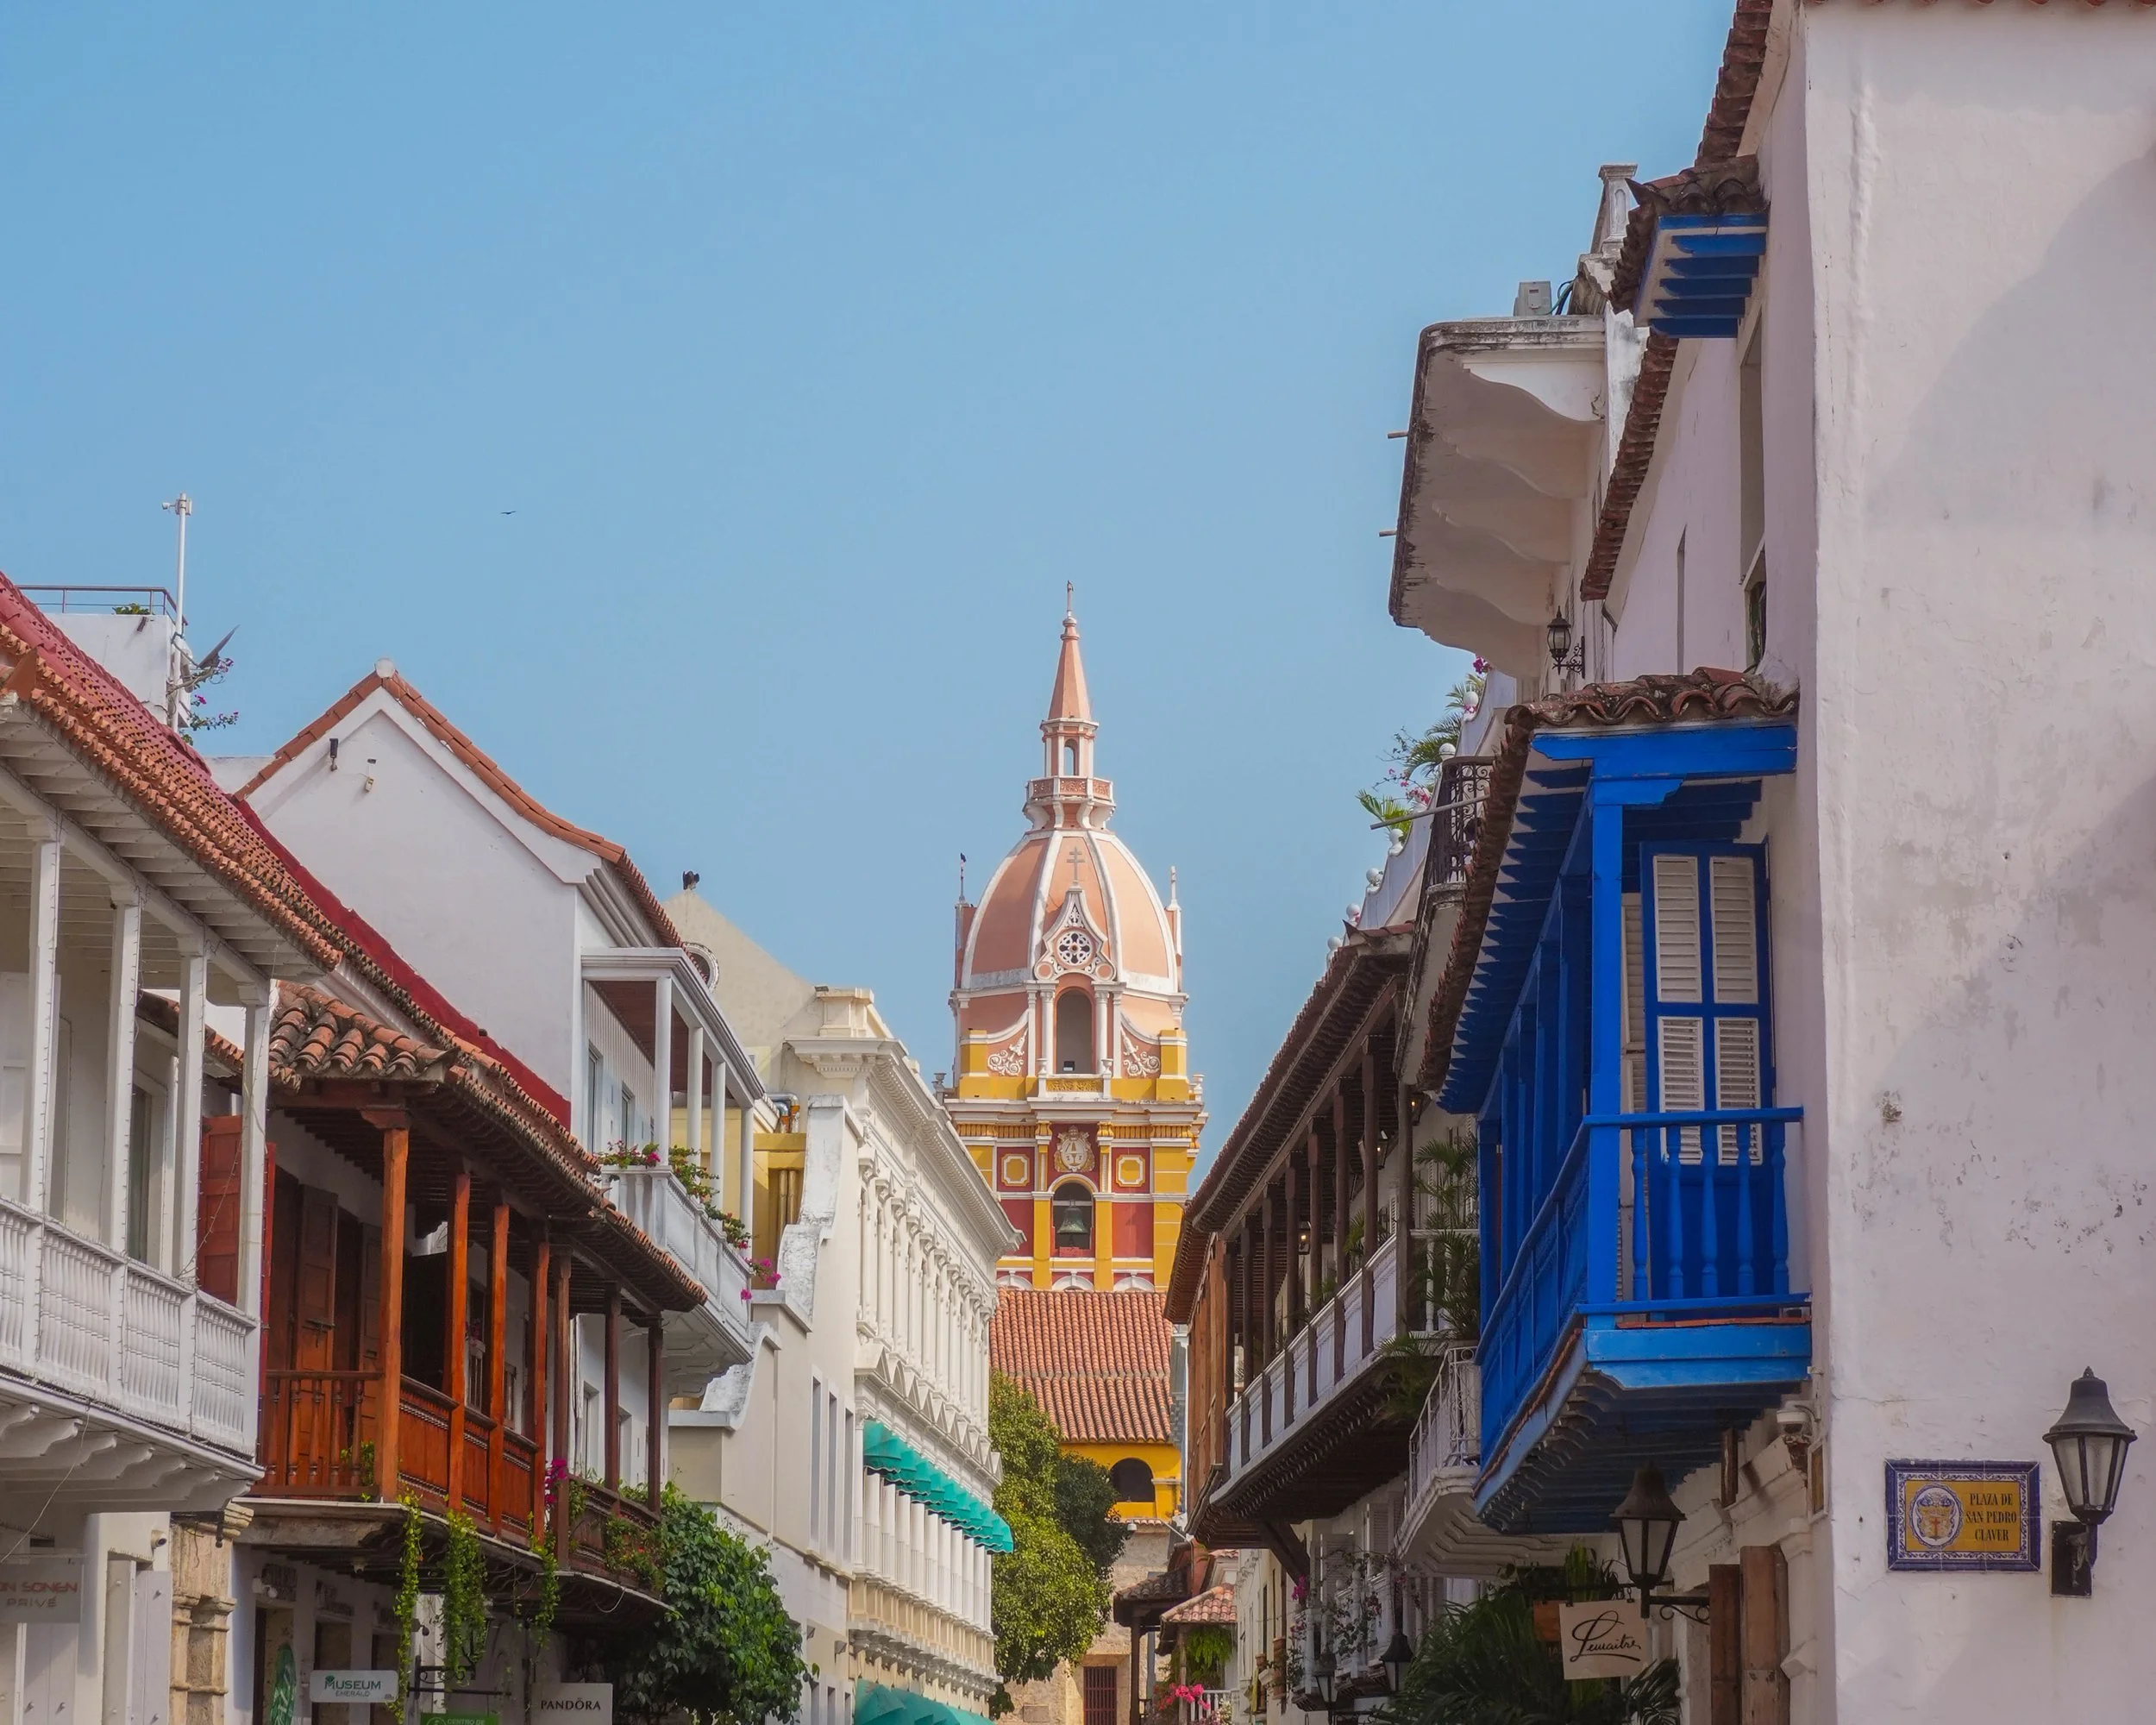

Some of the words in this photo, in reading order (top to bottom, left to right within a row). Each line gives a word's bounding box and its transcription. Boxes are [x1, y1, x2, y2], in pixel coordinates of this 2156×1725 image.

[1970, 1493, 1998, 1506] PLAZA
[2001, 1493, 2013, 1506] DE
[1966, 1511, 1984, 1523] SAN
[1986, 1511, 2017, 1524] PEDRO
[1975, 1529, 2009, 1541] CLAVER
[7, 1596, 57, 1608] PRIVÉ
[324, 1679, 381, 1690] MUSEUM
